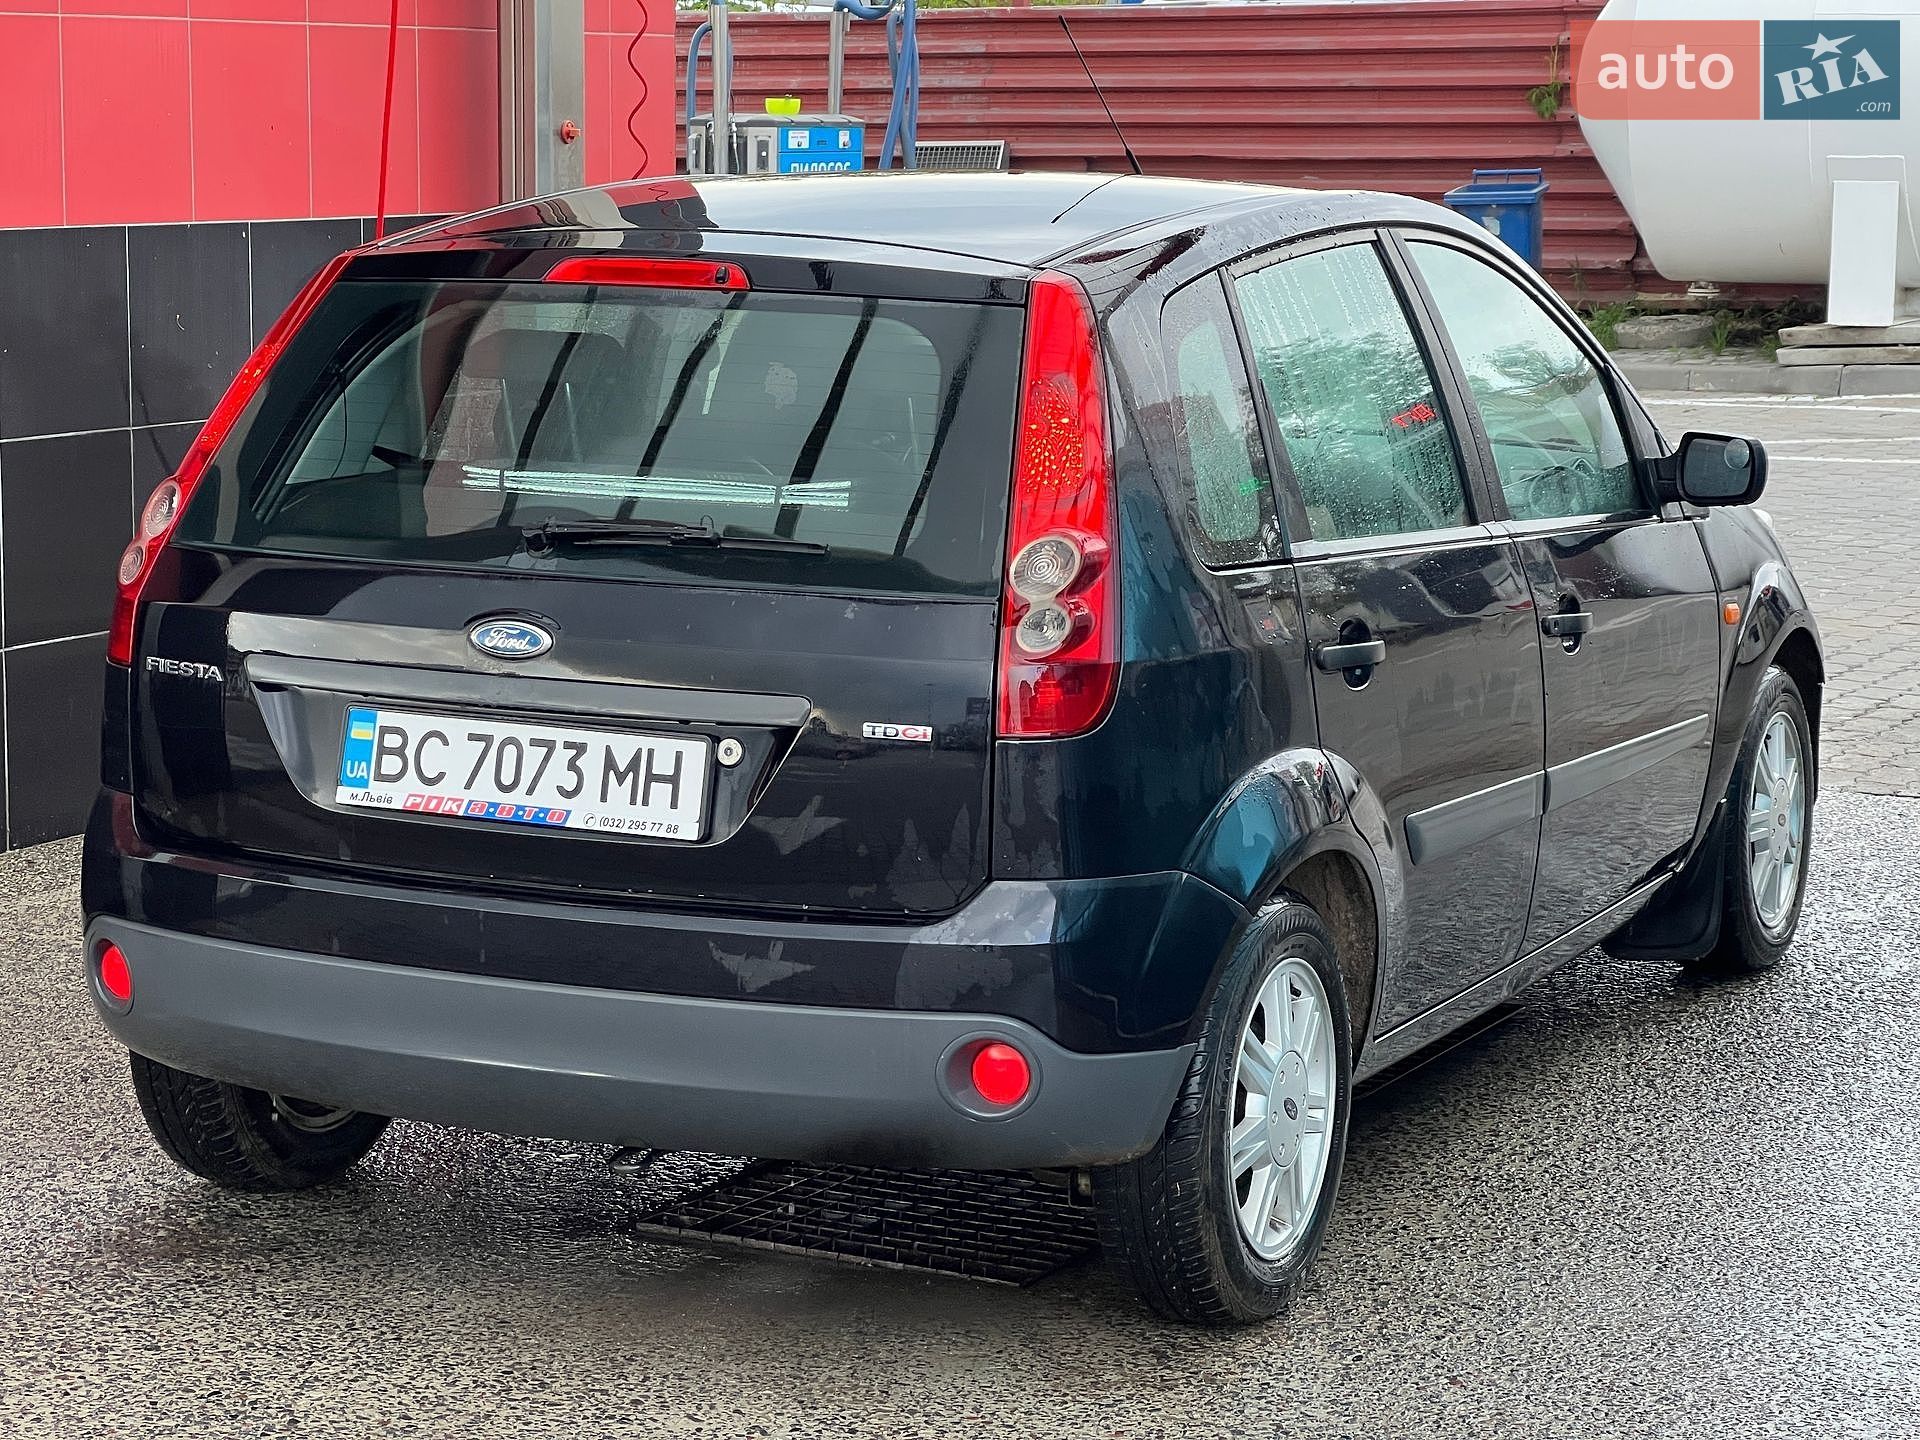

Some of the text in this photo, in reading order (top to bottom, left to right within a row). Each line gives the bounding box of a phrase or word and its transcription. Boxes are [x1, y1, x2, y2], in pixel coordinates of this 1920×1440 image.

[484, 627, 532, 651] Ford
[146, 656, 224, 682] FIESTA
[865, 724, 929, 740] TDCi
[345, 760, 369, 780] UA
[373, 725, 684, 810] BC 7073 MH
[599, 815, 680, 835] (032) 295 77 88
